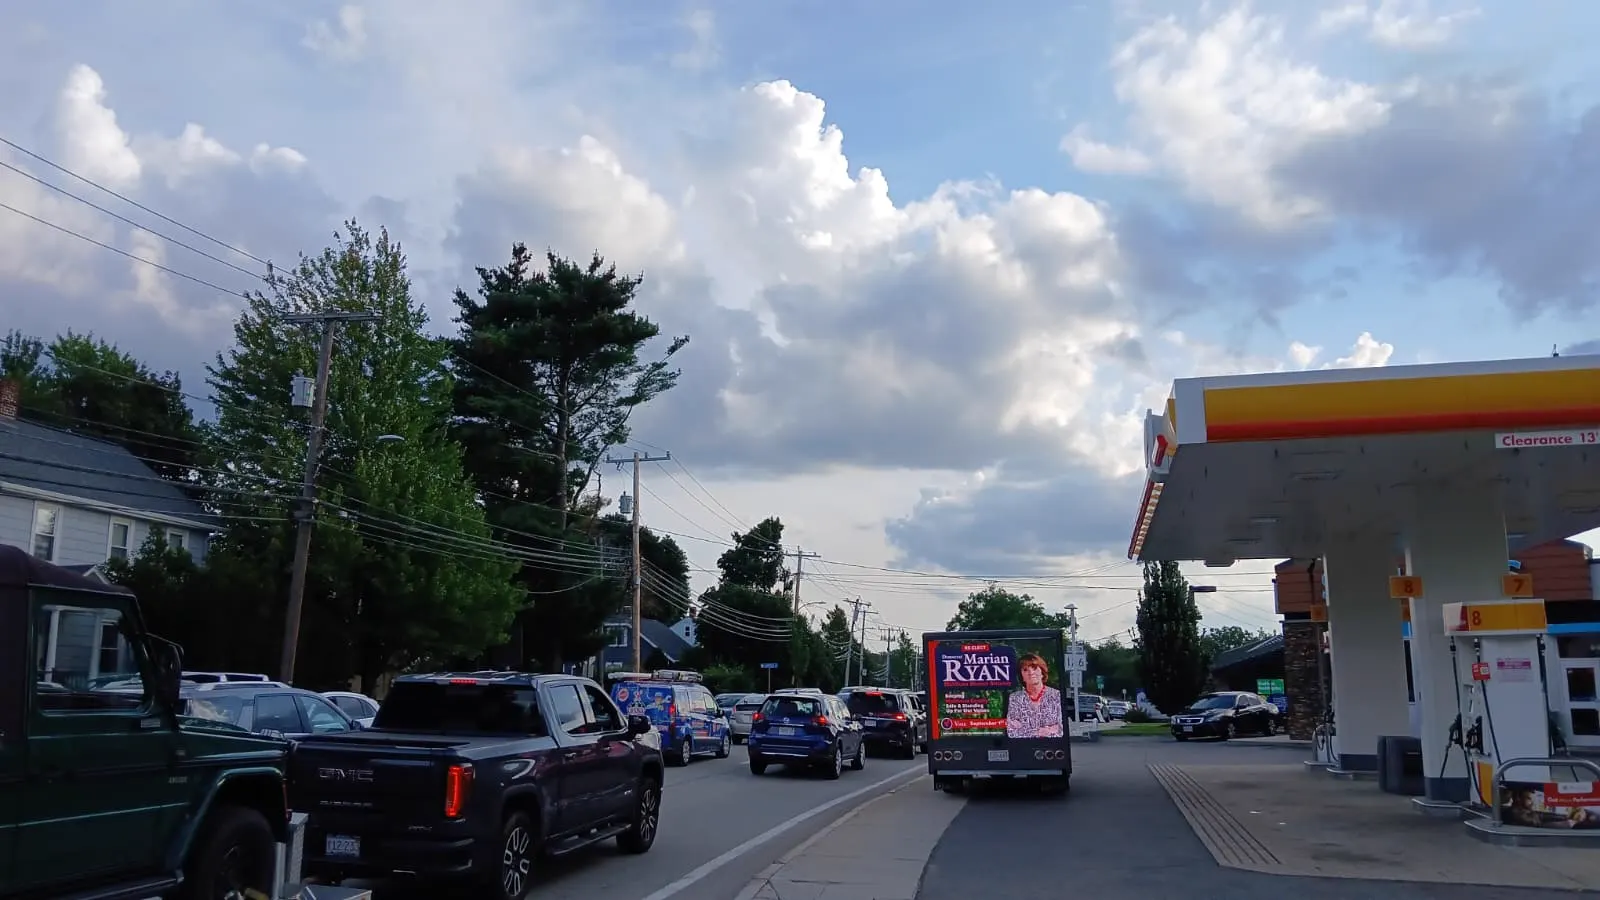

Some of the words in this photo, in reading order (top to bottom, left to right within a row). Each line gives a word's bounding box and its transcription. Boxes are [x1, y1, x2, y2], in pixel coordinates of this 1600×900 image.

[1502, 434, 1573, 446] Clearance
[1404, 580, 1413, 594] 8
[1514, 579, 1524, 593] 7
[1472, 610, 1481, 626] 8
[963, 653, 1010, 665] Marian
[942, 660, 1010, 681] RYAN
[319, 767, 374, 782] GMC
